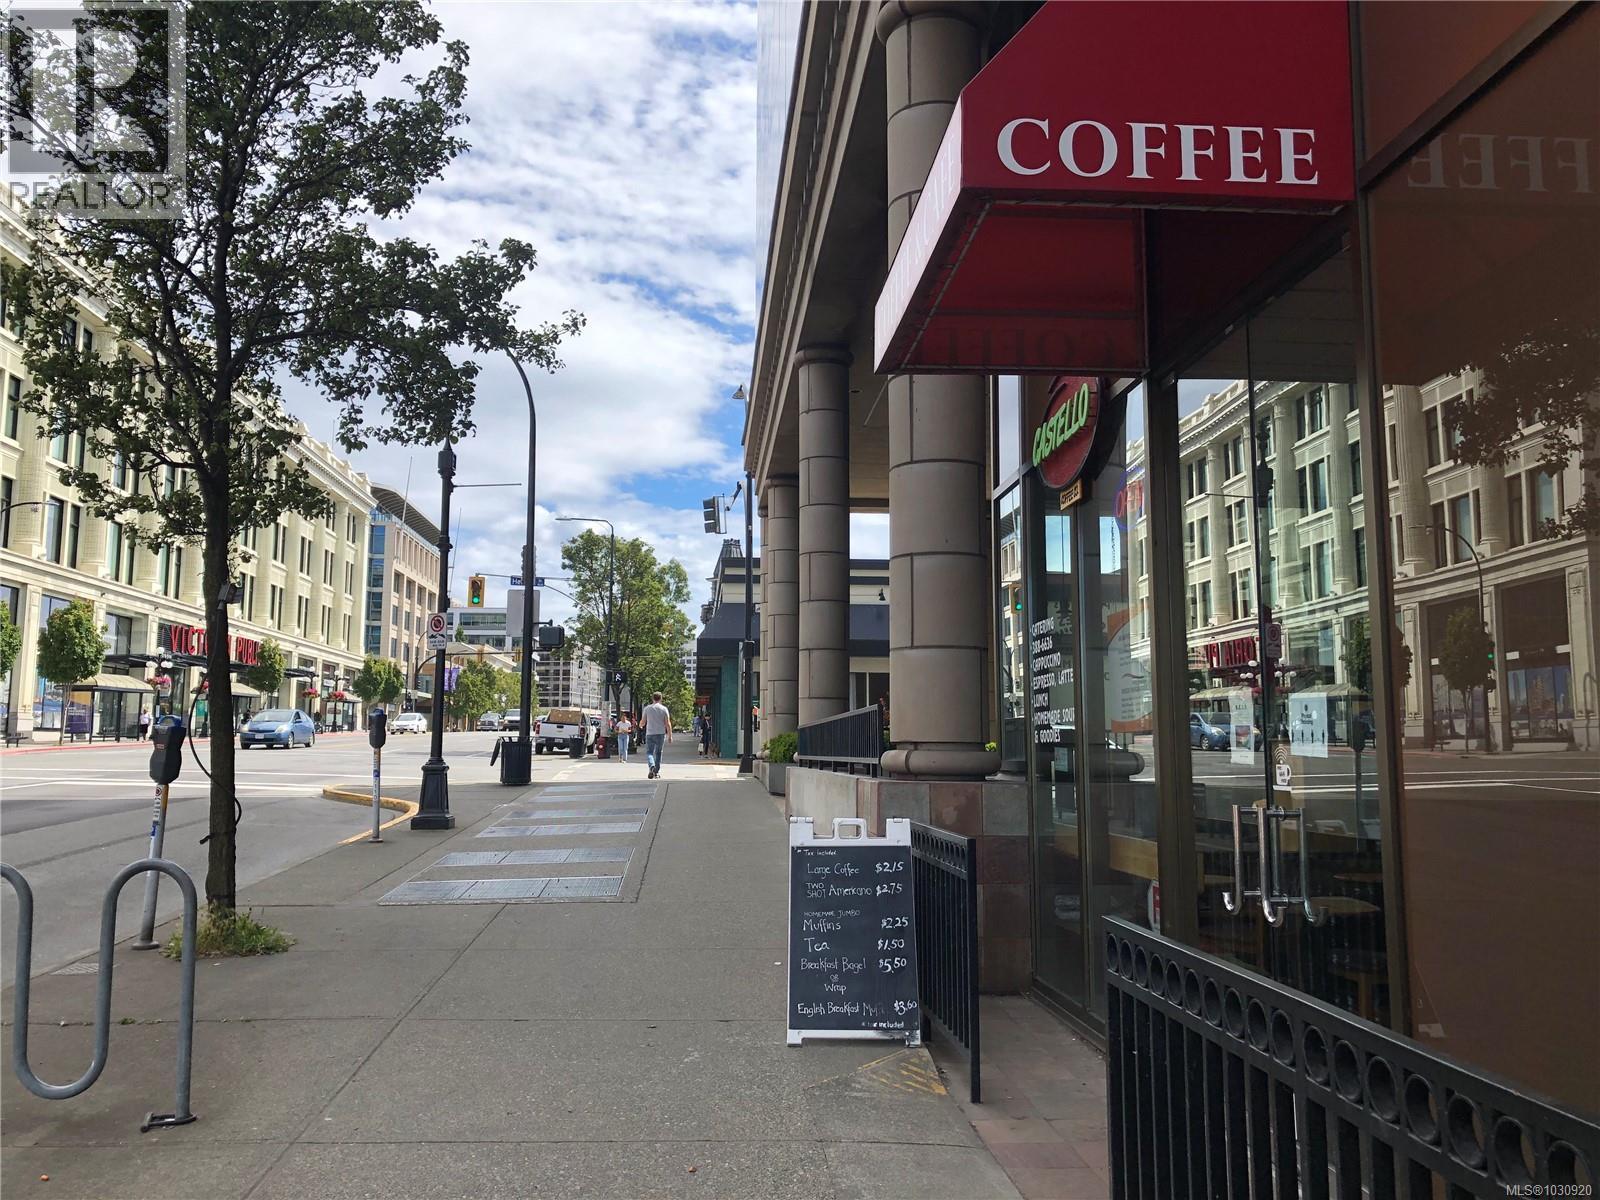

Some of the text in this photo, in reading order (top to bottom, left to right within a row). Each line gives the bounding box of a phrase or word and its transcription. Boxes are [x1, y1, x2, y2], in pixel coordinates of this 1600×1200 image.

[997, 117, 1319, 186] COFFEE
[1033, 383, 1088, 467] CASTELLO
[1032, 617, 1054, 637] CATERING
[1033, 651, 1060, 672] CAPPUCCINO
[1033, 668, 1073, 690] ESPRESSO, LATTE
[1033, 692, 1049, 708] LUNCH
[1033, 709, 1060, 726] HOMEMADE
[1034, 728, 1060, 744] & GOODIES
[807, 861, 904, 879] Large Coffee $2.15
[806, 883, 903, 899] SHOT Americano $2.75
[837, 909, 861, 919] JUMBO
[803, 916, 909, 933] Muffins $2.25
[804, 937, 905, 953] Tea $1.50
[800, 957, 907, 974] Breakfast Bagel $5.50
[823, 983, 847, 995] Wrap
[797, 1003, 826, 1018] English
[827, 1002, 859, 1016] Breakfast
[893, 1000, 918, 1016] $3.60
